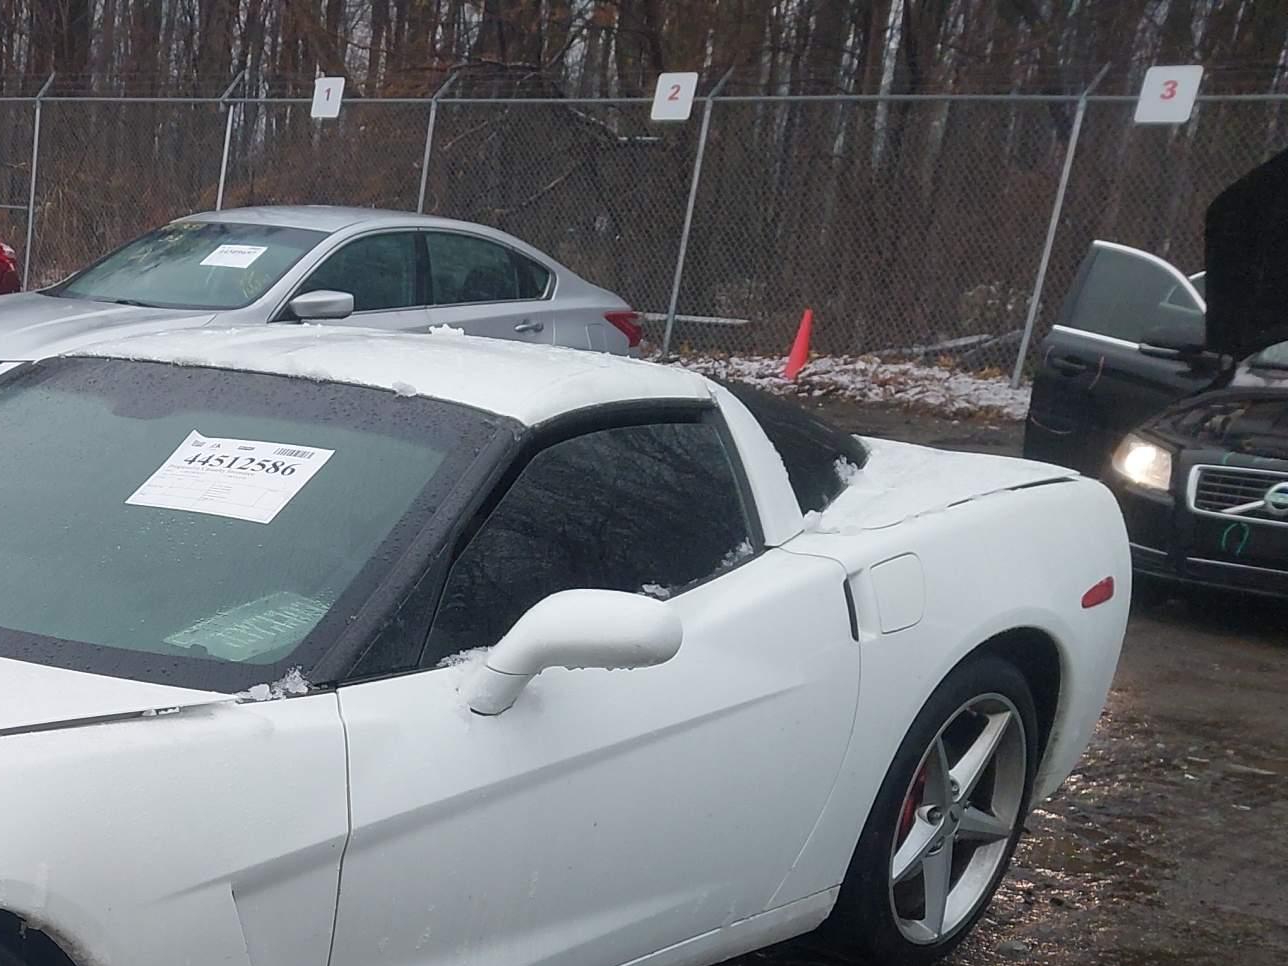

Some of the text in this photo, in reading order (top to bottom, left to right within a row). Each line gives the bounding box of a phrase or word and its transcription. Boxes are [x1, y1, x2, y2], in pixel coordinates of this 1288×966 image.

[325, 88, 331, 101] 1
[668, 84, 680, 100] 2
[1160, 80, 1178, 100] 3
[185, 453, 300, 476] 44512586
